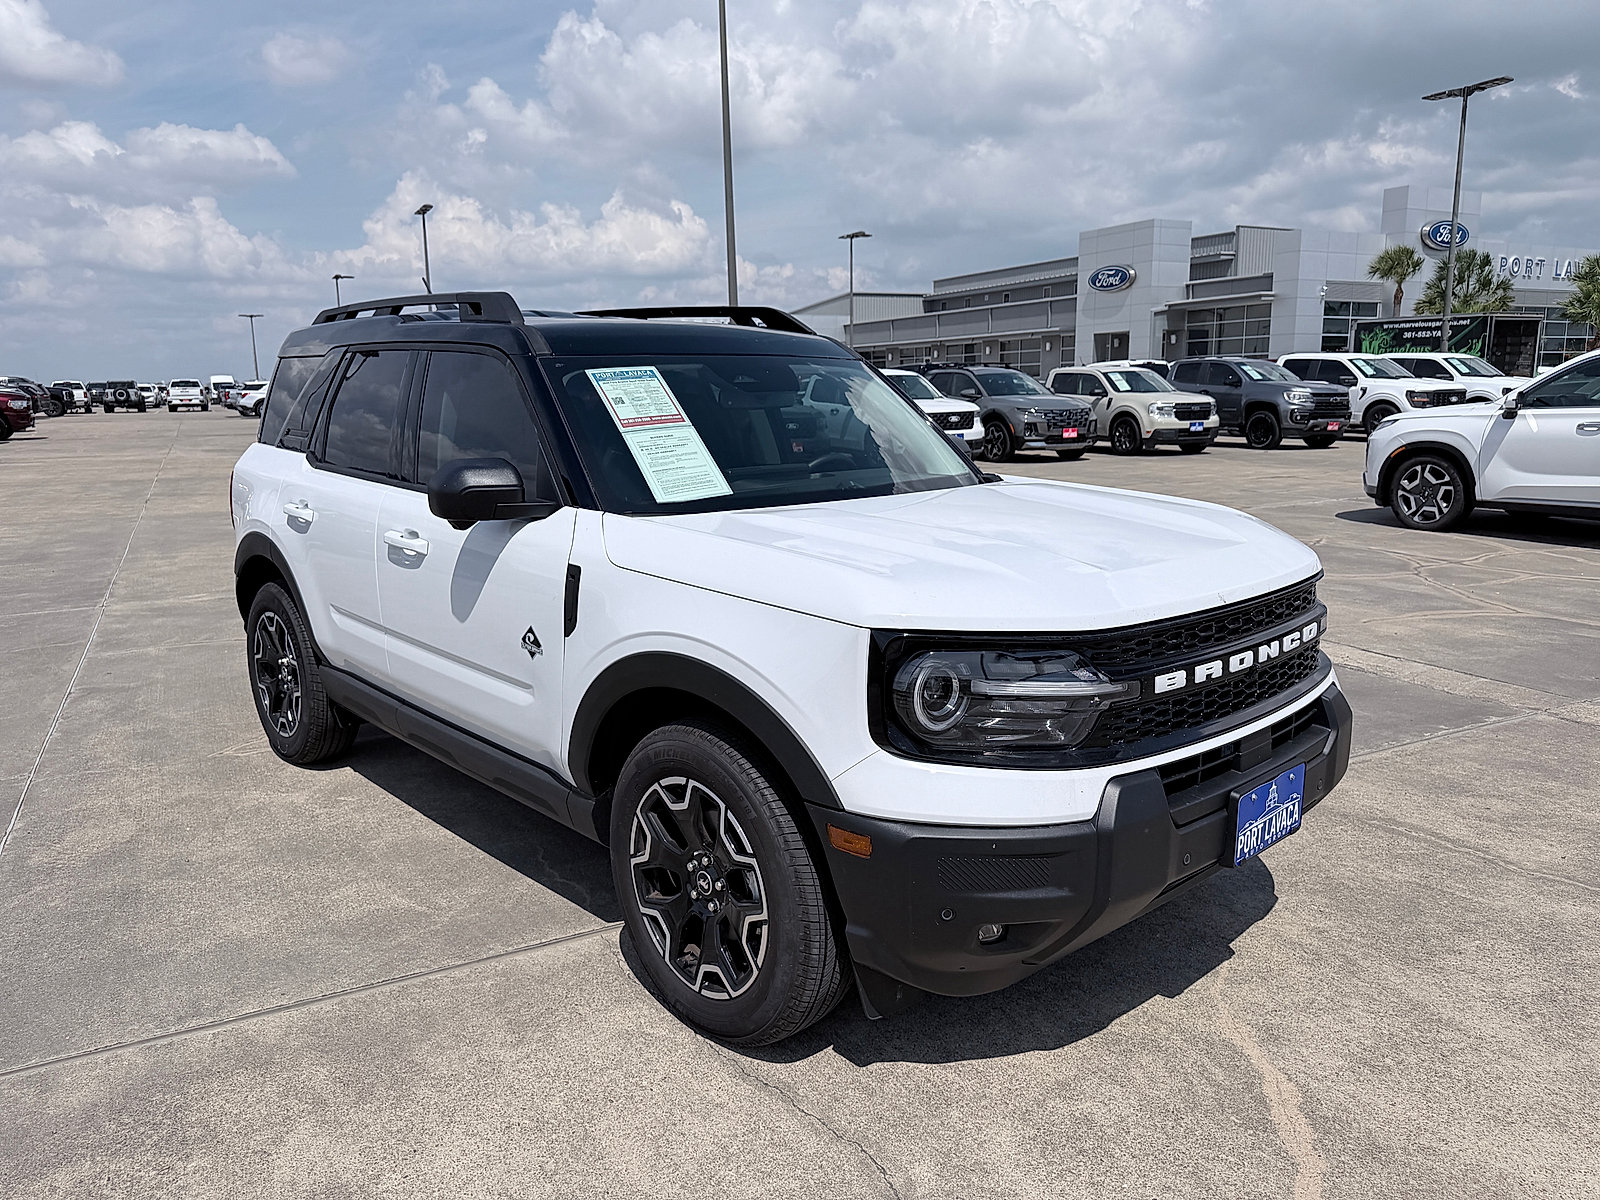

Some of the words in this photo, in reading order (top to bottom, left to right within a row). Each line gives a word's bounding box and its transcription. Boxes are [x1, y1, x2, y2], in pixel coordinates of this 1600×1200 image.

[1436, 225, 1463, 243] Fod
[1499, 255, 1546, 276] PORT
[1095, 270, 1122, 287] Ford
[1383, 320, 1470, 329] www.marvelousgarns.net
[1402, 330, 1452, 338] 361-552-YAD
[623, 370, 653, 378] LAVACA
[1154, 621, 1318, 694] BRONCO
[1237, 823, 1264, 859] PORT
[1264, 801, 1299, 841] LAVACA
[1246, 842, 1264, 860] AUTO
[1267, 825, 1292, 844] GROUP
